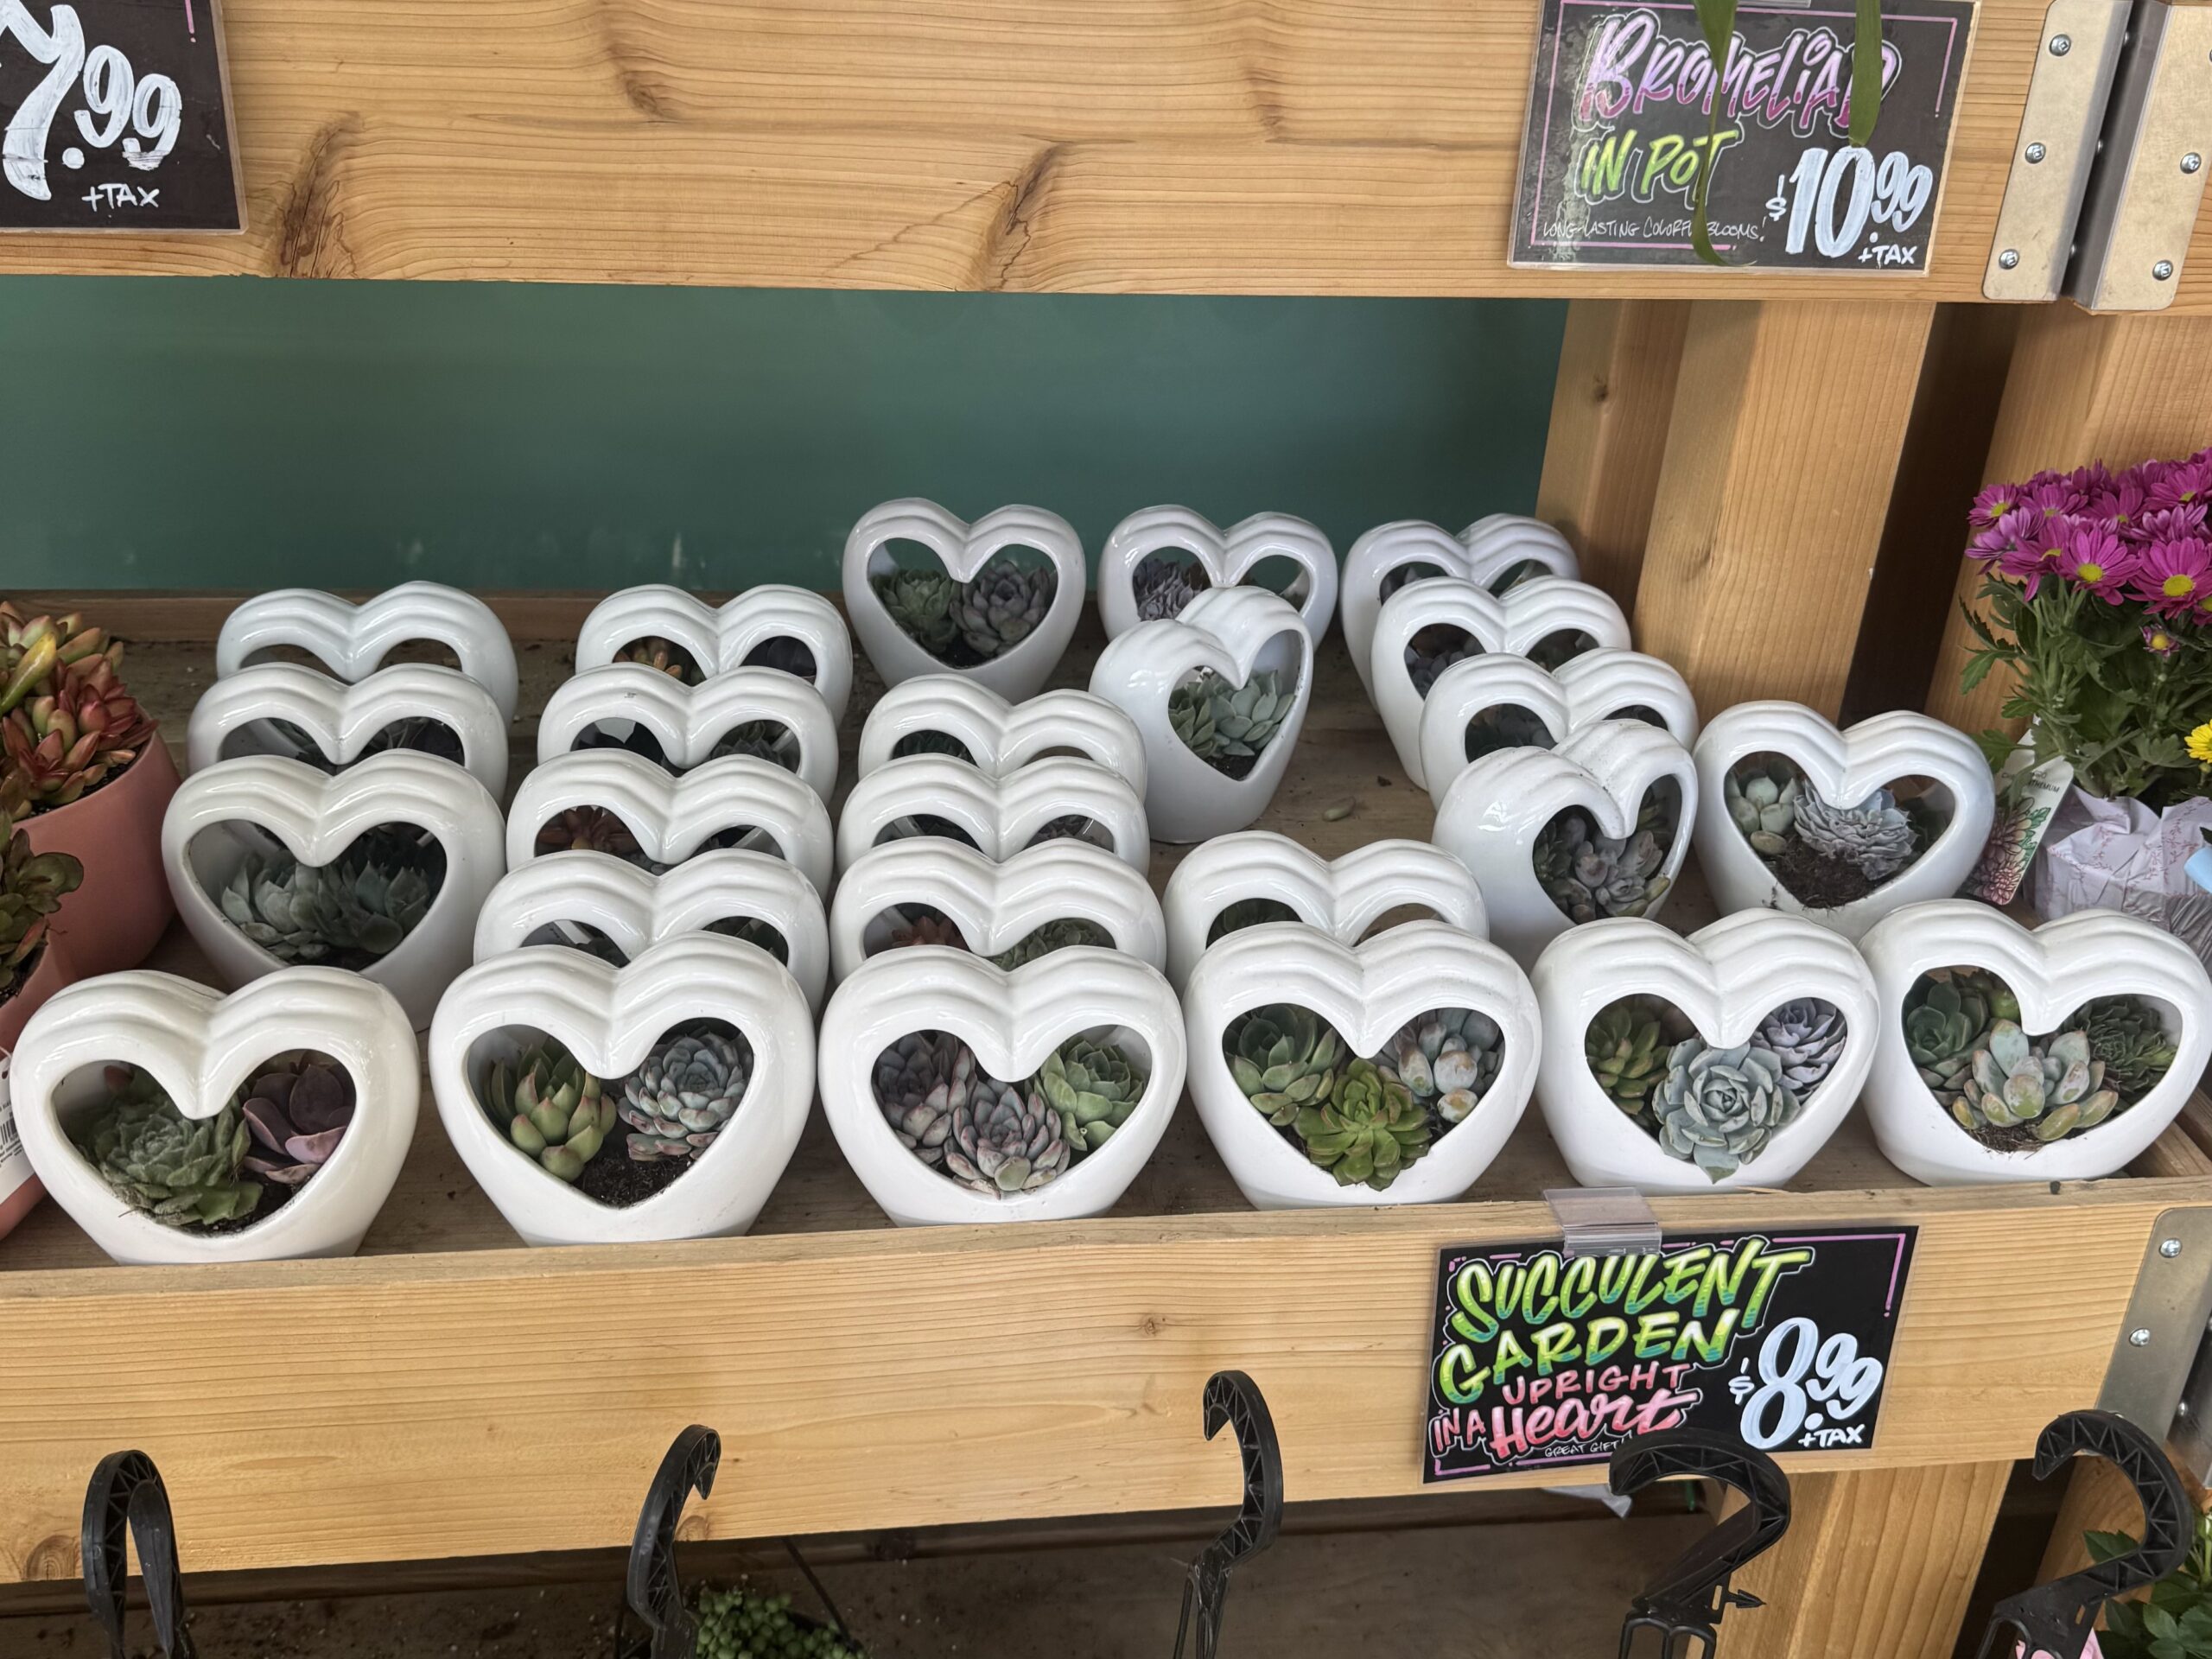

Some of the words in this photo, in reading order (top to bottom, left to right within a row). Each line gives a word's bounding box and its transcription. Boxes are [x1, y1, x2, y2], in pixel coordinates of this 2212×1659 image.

[1580, 129, 1638, 196] IN
[1640, 130, 1740, 202] POT
[82, 183, 160, 212] +TAX
[1643, 215, 1693, 238] COLORF
[1765, 145, 1934, 257] $10.99
[1858, 245, 1917, 266] +TAX
[1451, 1236, 1813, 1343] SUCCULENT
[1440, 1308, 1739, 1404] GARDEN
[1502, 1360, 1691, 1405] UPRIGHT
[1728, 1317, 1884, 1449] $8.99
[1433, 1407, 1460, 1452] IN
[1466, 1408, 1487, 1446] A
[1489, 1388, 1699, 1459] Heart
[1544, 1443, 1586, 1458] GREAT
[1796, 1423, 1866, 1447] +TAX
